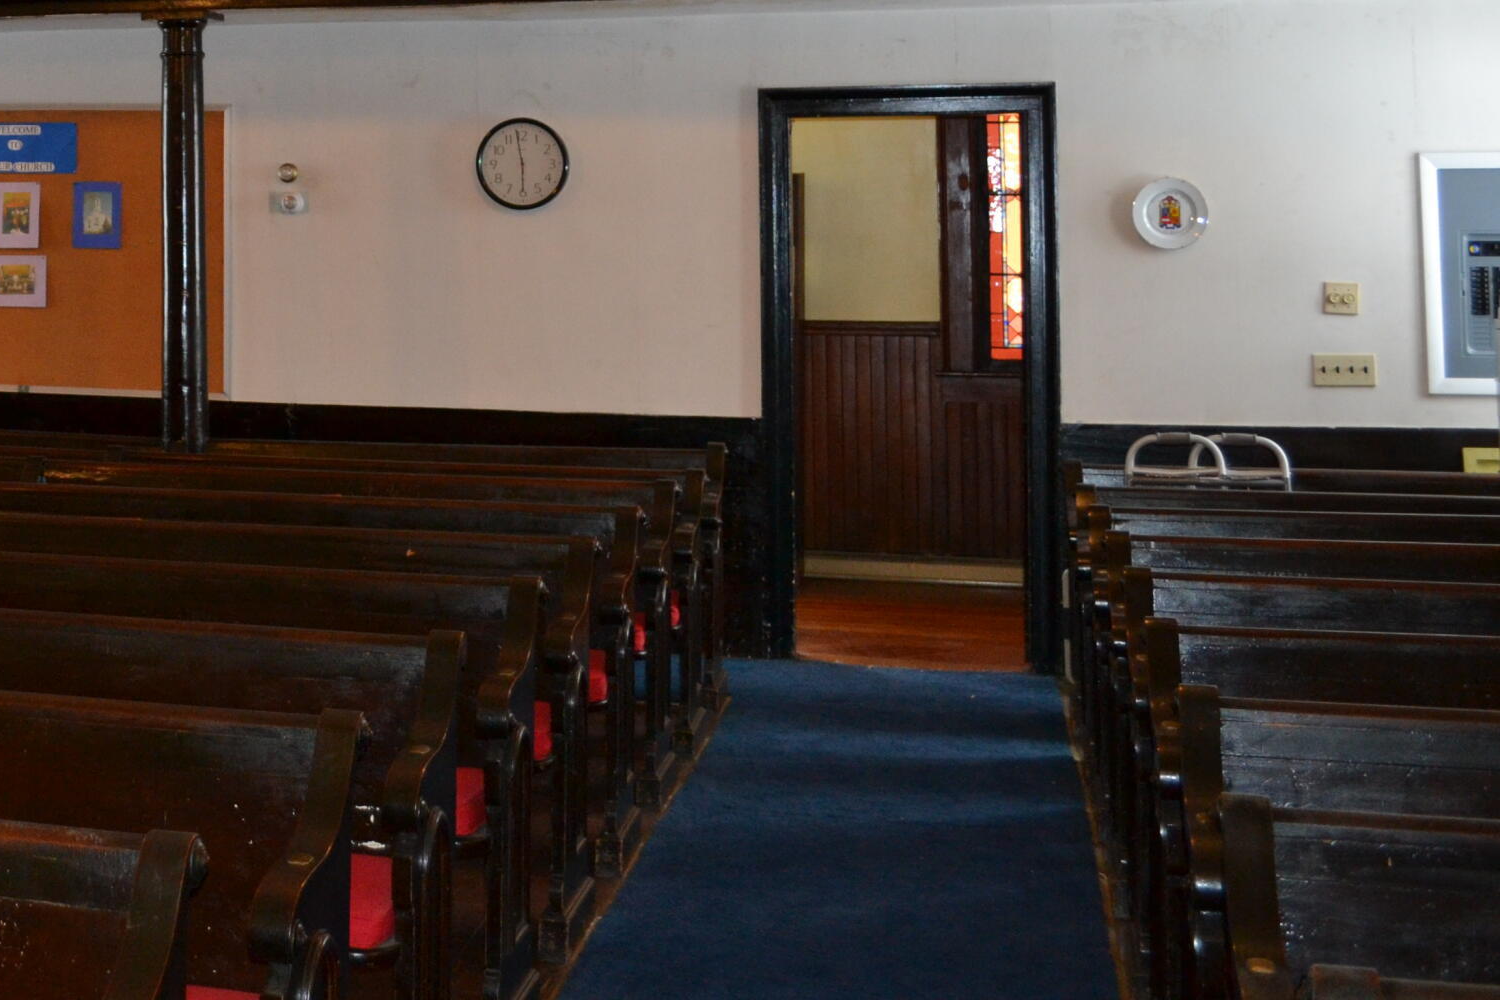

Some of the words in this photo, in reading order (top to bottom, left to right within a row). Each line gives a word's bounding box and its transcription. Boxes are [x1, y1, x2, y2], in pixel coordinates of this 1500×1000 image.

[504, 134, 513, 144] 11
[10, 141, 22, 149] TO
[493, 145, 505, 155] 10
[543, 144, 551, 155] 2
[490, 159, 498, 169] 9
[549, 159, 556, 169] 3
[494, 173, 502, 183] 8
[544, 173, 551, 184] 4
[506, 184, 513, 194] 7
[534, 183, 542, 194] 5
